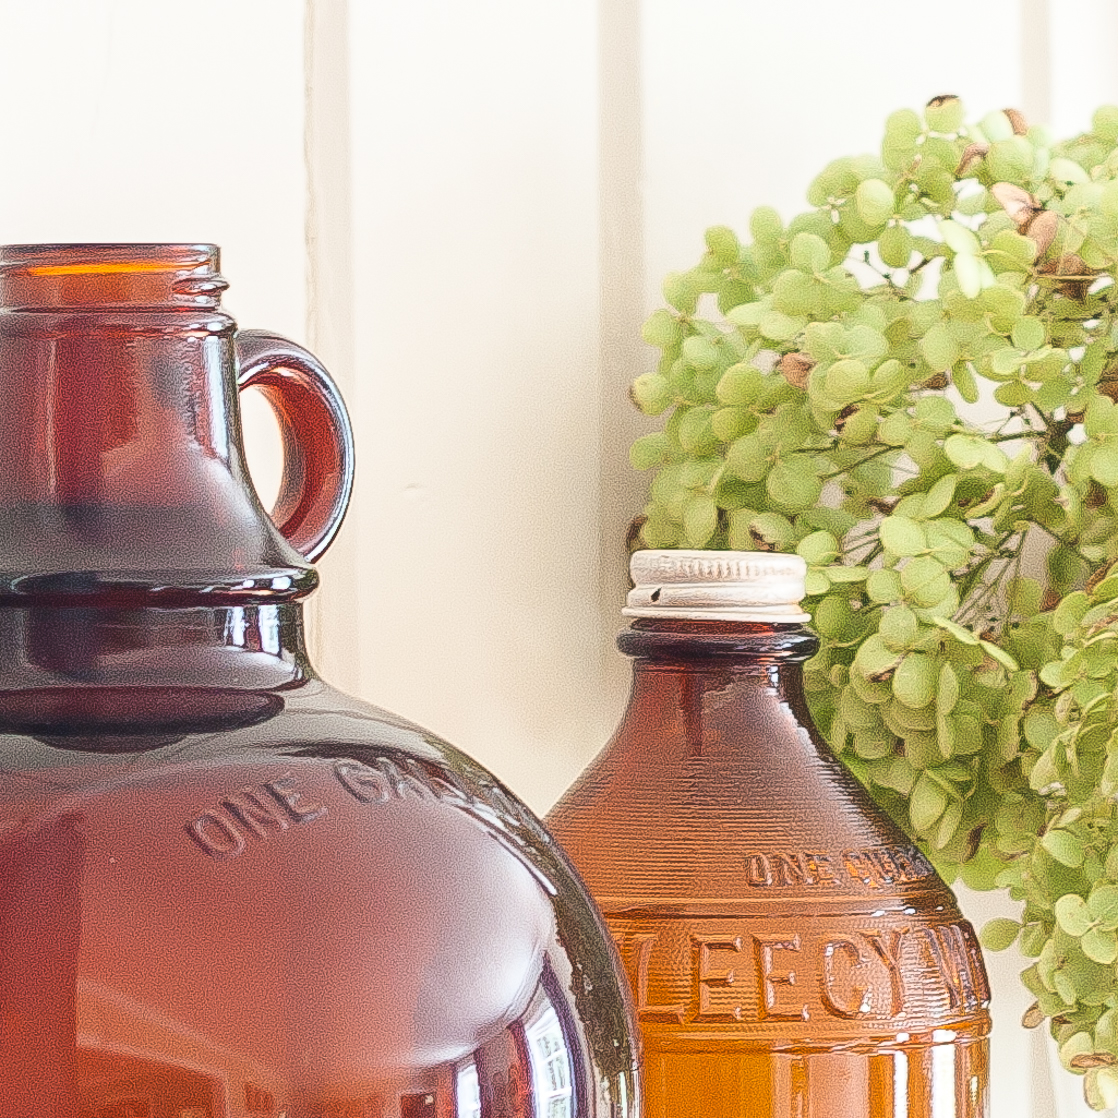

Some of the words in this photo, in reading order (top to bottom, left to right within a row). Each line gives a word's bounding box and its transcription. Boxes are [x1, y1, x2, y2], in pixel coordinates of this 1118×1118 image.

[184, 770, 328, 859] ONE
[745, 849, 841, 887] ONE
[612, 925, 911, 1024] LEECY
